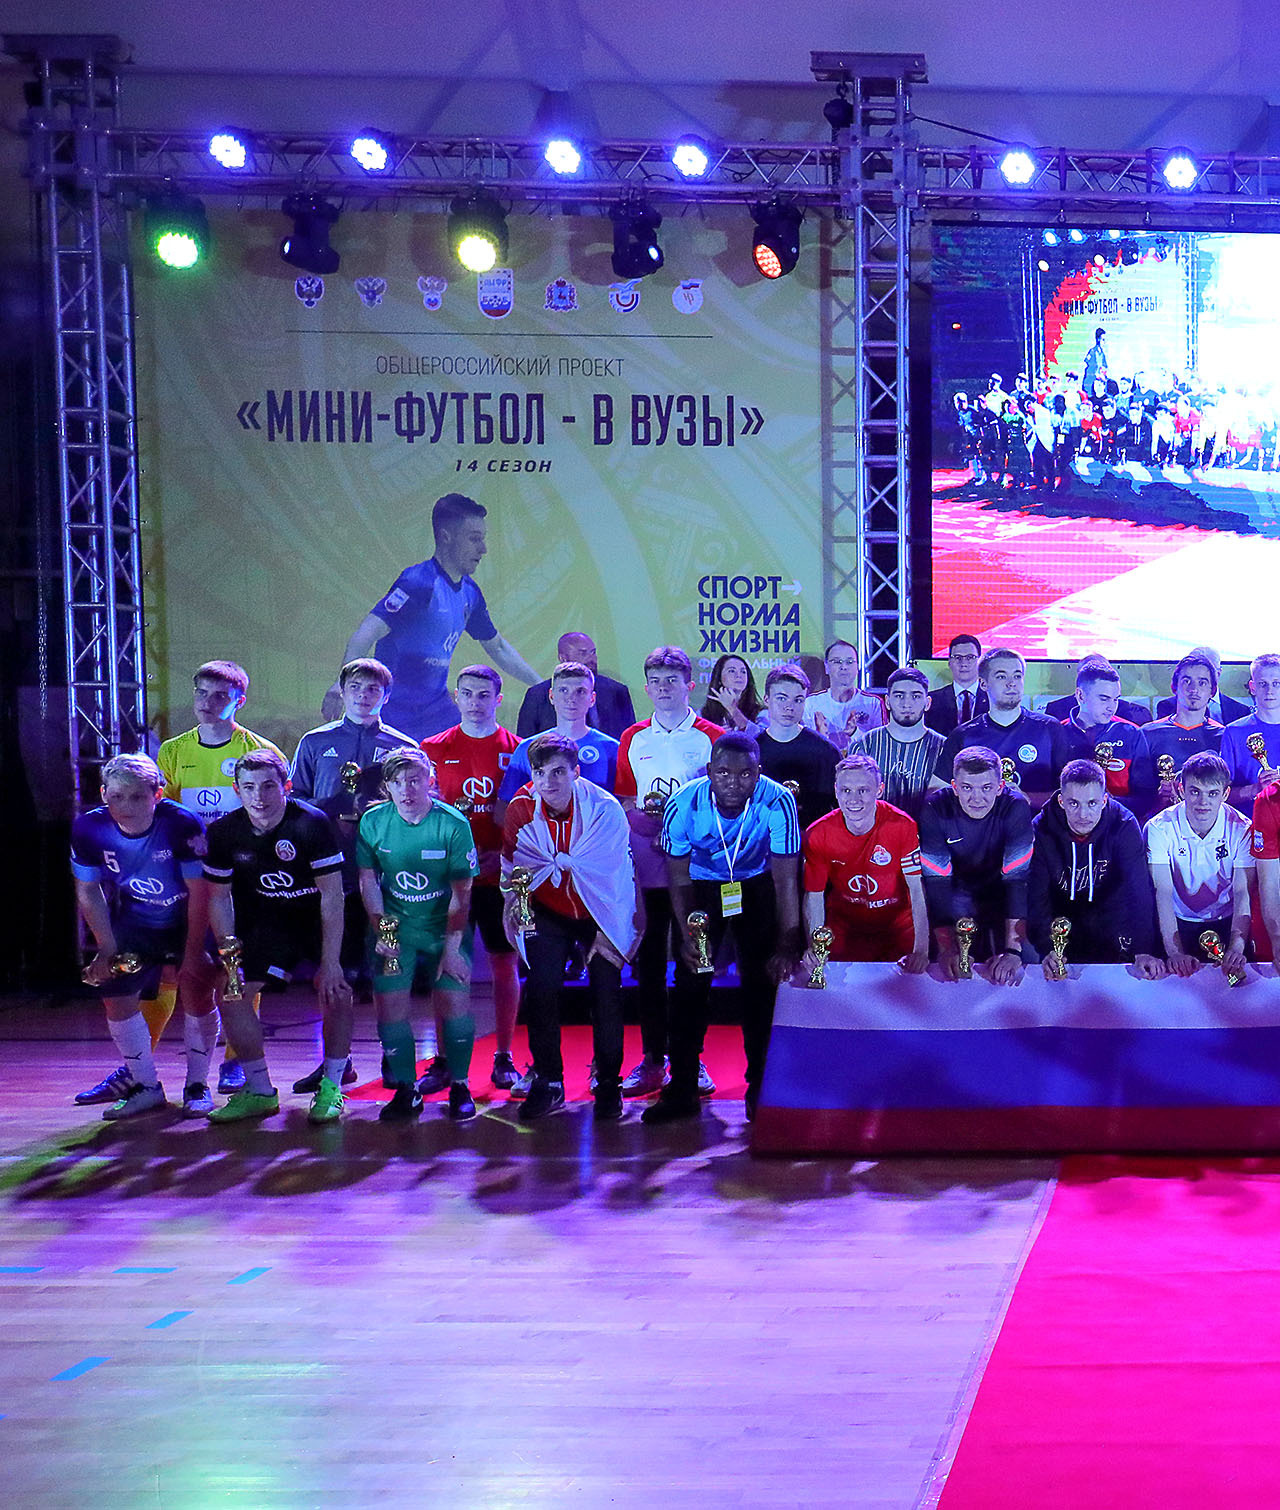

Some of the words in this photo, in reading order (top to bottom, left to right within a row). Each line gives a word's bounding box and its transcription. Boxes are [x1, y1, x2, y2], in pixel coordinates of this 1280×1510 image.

[376, 354, 551, 377] ОБЩЕРОССИЙСКИЙ
[558, 358, 625, 377] ПРОЕКТ
[236, 389, 545, 446] «МИНИ-ФУТБОЛ
[592, 393, 614, 446] В
[631, 394, 765, 447] ВУЗЫ»
[455, 459, 478, 472] 14
[487, 459, 552, 473] СЕЗОН
[698, 576, 782, 599] СПОРТ
[698, 603, 800, 626] НОРМА
[698, 630, 800, 653] ЖИЗНИ
[103, 850, 121, 873] 5
